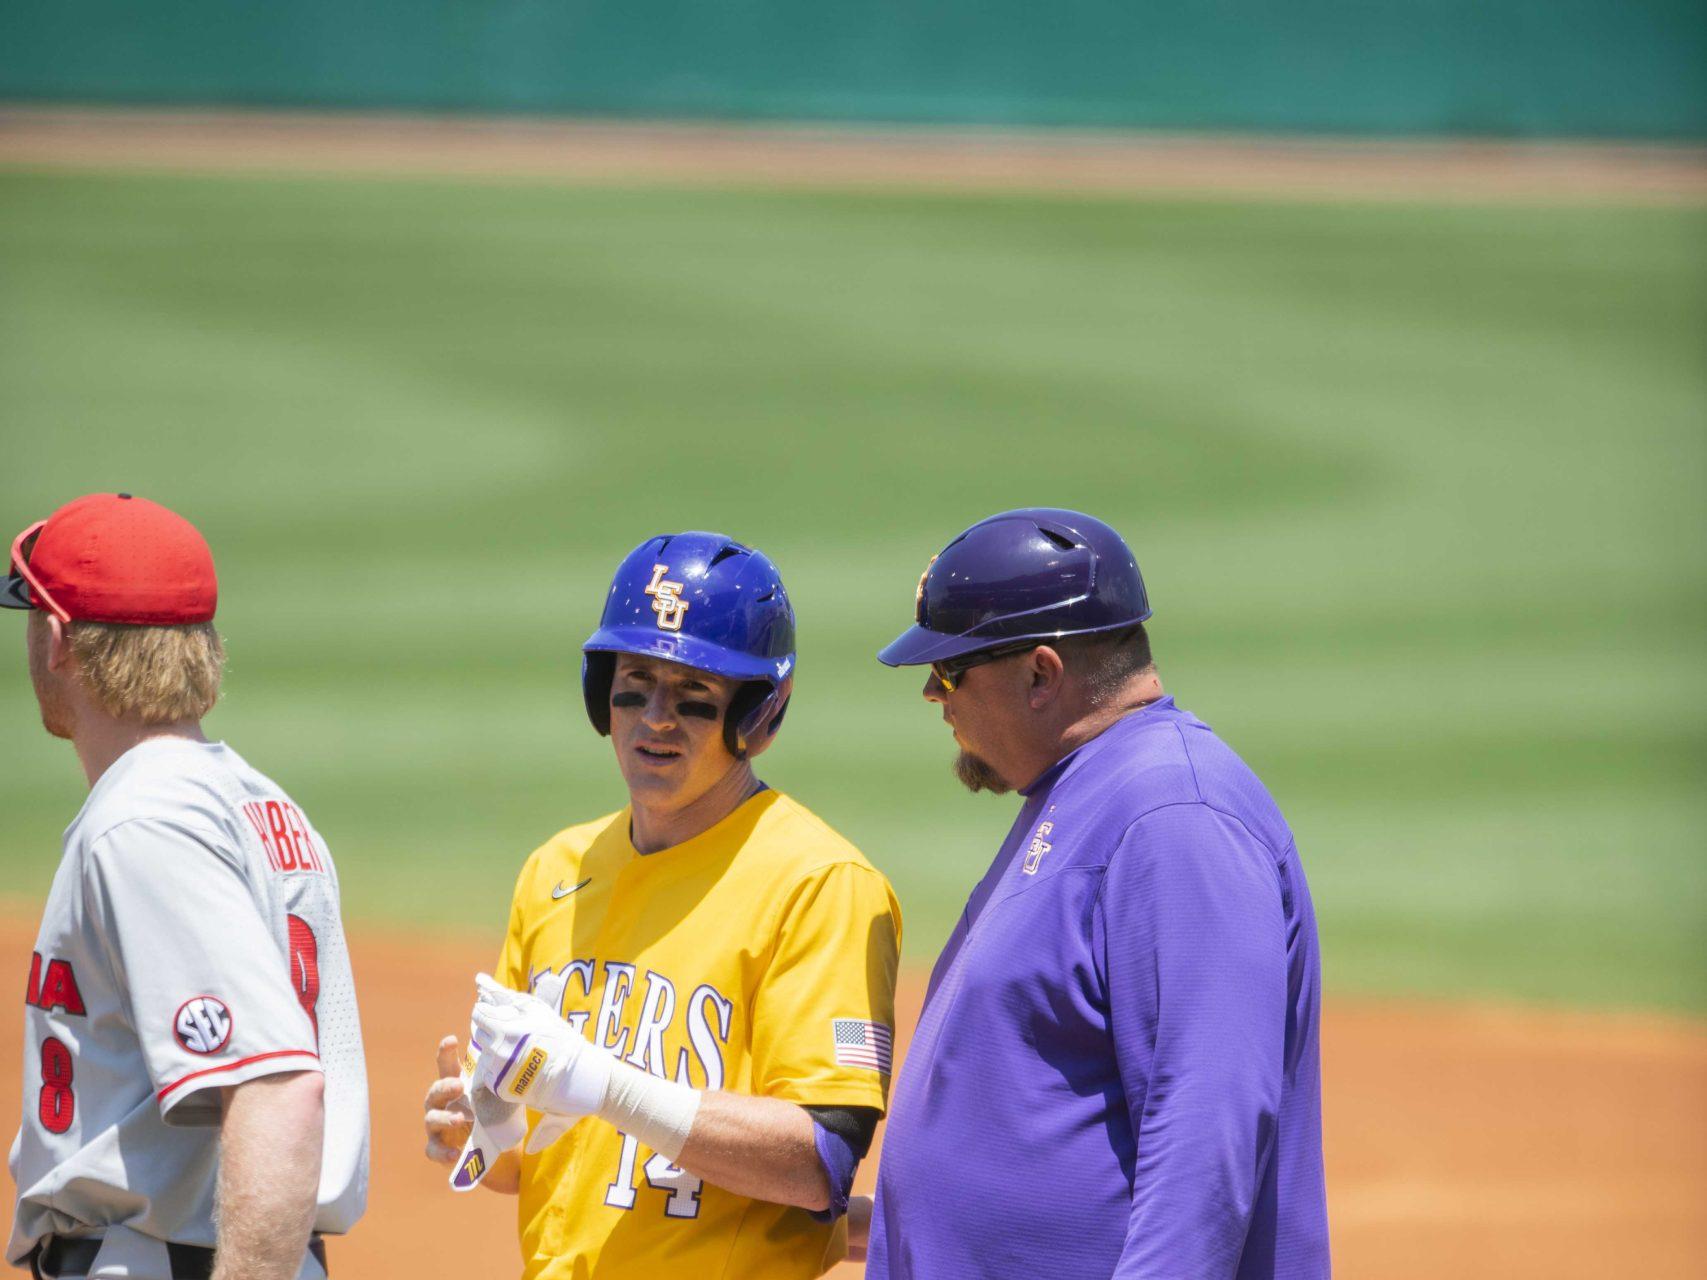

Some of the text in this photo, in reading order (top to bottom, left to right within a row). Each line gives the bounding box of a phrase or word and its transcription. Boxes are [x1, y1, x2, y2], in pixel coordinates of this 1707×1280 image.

[645, 563, 690, 631] LSU
[176, 998, 231, 1053] SEC
[528, 958, 733, 1090] GERS
[39, 1036, 74, 1135] 8
[514, 1048, 544, 1096] marucci
[604, 1129, 704, 1219] 14
